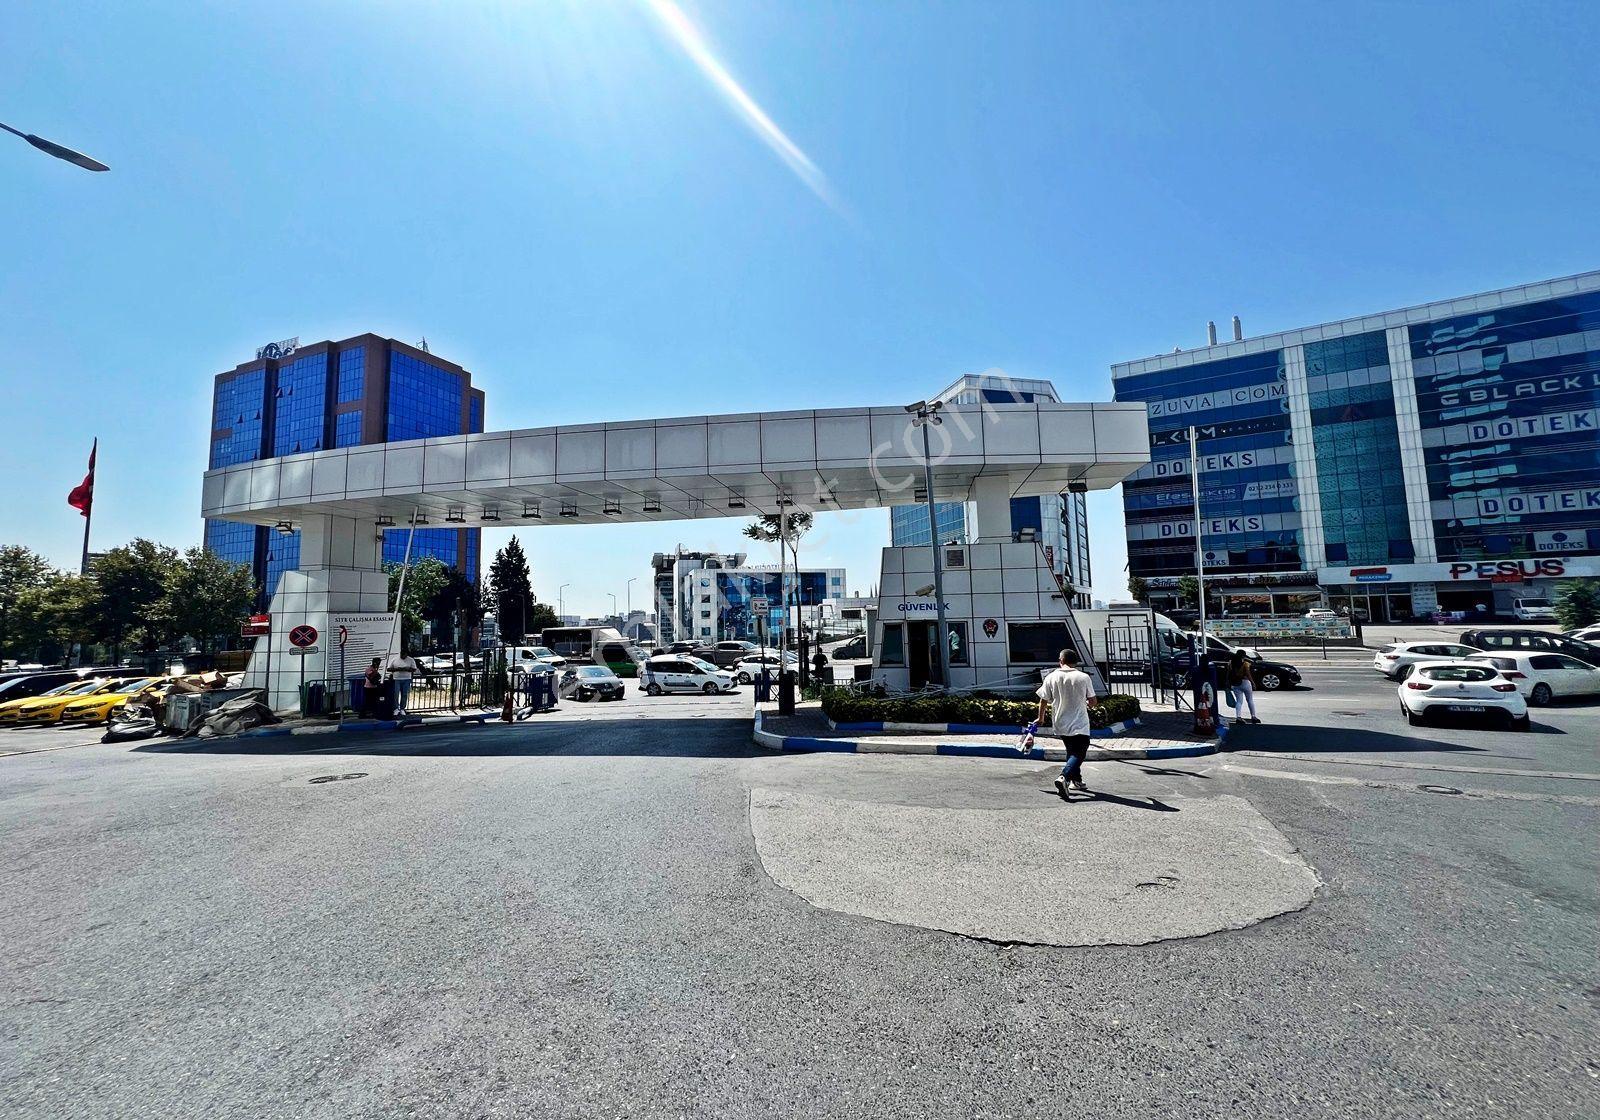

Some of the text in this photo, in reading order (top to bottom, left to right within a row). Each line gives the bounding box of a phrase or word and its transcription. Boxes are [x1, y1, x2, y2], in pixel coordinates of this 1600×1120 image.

[1152, 385, 1287, 415] ZUVA.COM
[1470, 376, 1582, 402] BLACK
[1473, 413, 1592, 440] DOTEK
[1450, 559, 1565, 579] PESUS
[898, 602, 950, 611] GÜVENLK
